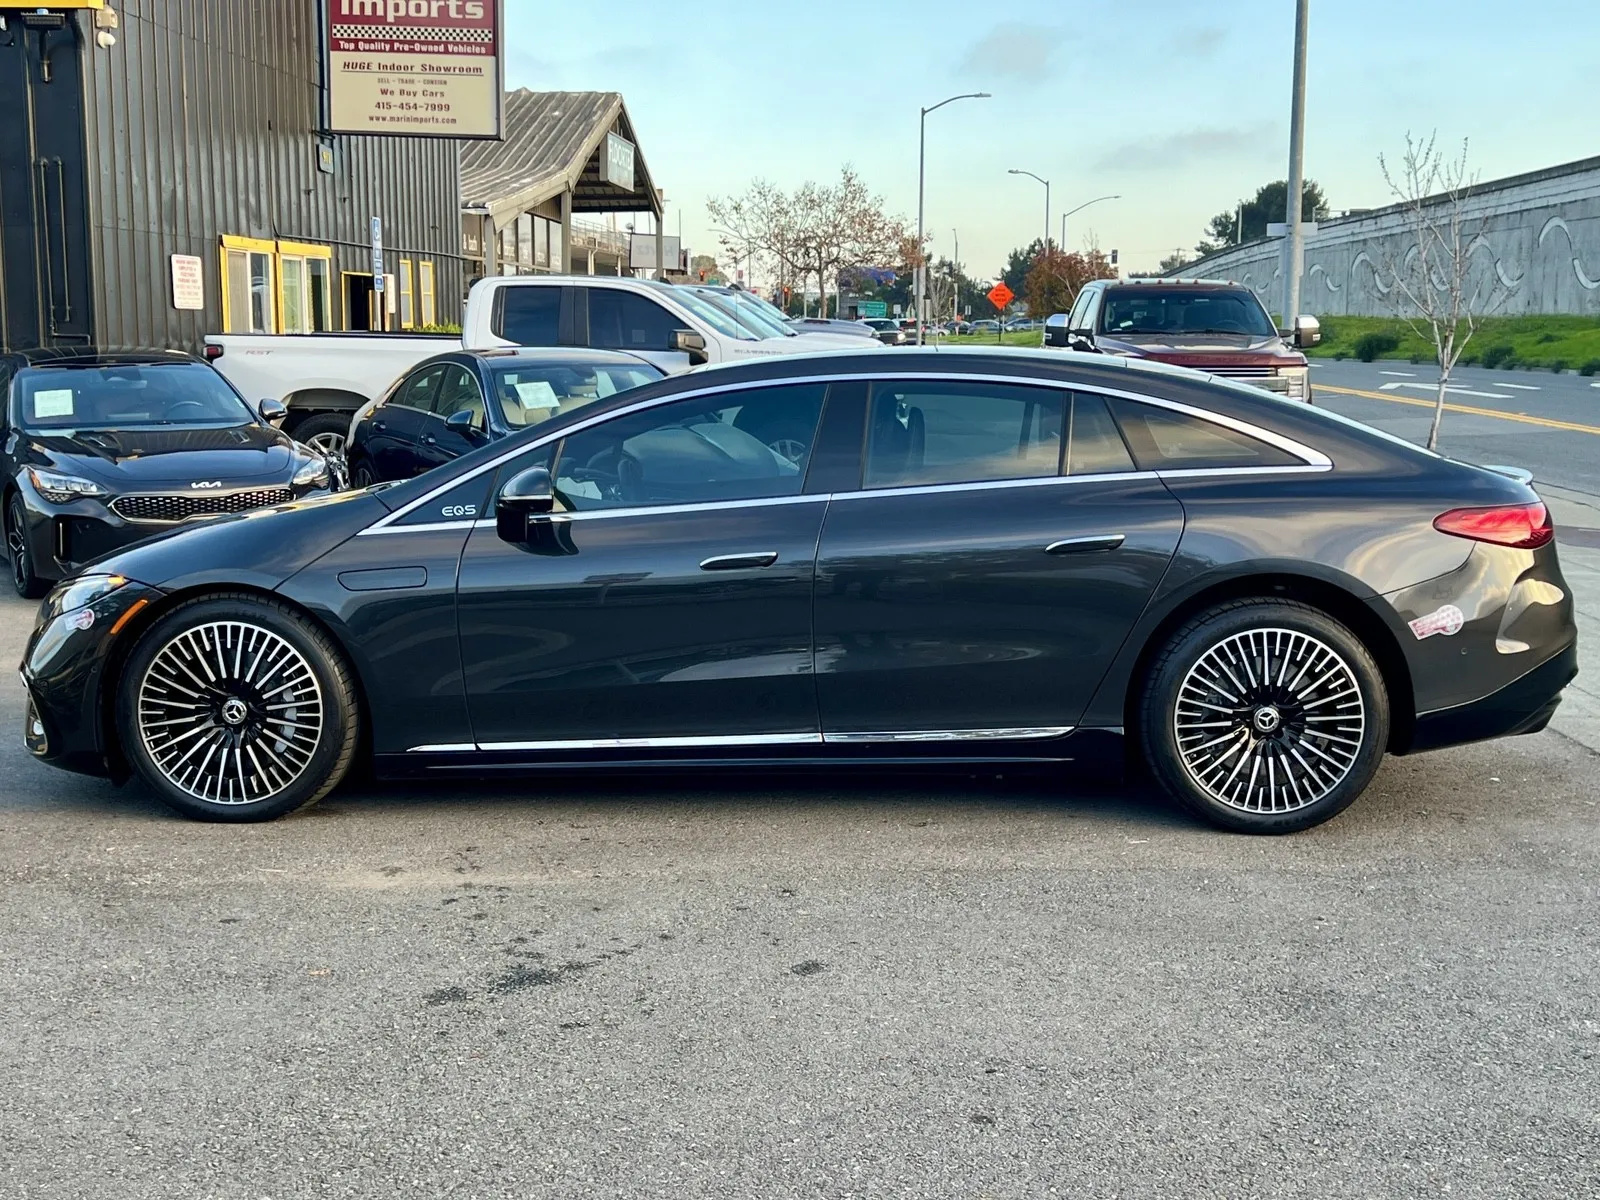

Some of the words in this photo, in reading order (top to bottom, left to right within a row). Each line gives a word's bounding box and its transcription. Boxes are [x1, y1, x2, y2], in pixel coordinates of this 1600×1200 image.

[338, 40, 355, 51] Top
[358, 41, 391, 52] Quality
[393, 42, 445, 53] Pre-Owned
[447, 44, 486, 54] Vehicles
[343, 61, 374, 71] HUGE
[377, 62, 415, 72] Indoor
[420, 63, 483, 74] Showroom
[380, 88, 395, 97] We
[399, 89, 418, 98] Buy
[422, 89, 445, 98] Cars
[374, 101, 451, 112] 415-454-7999
[368, 114, 457, 125] www.marinimports.com
[441, 504, 477, 517] EQS
